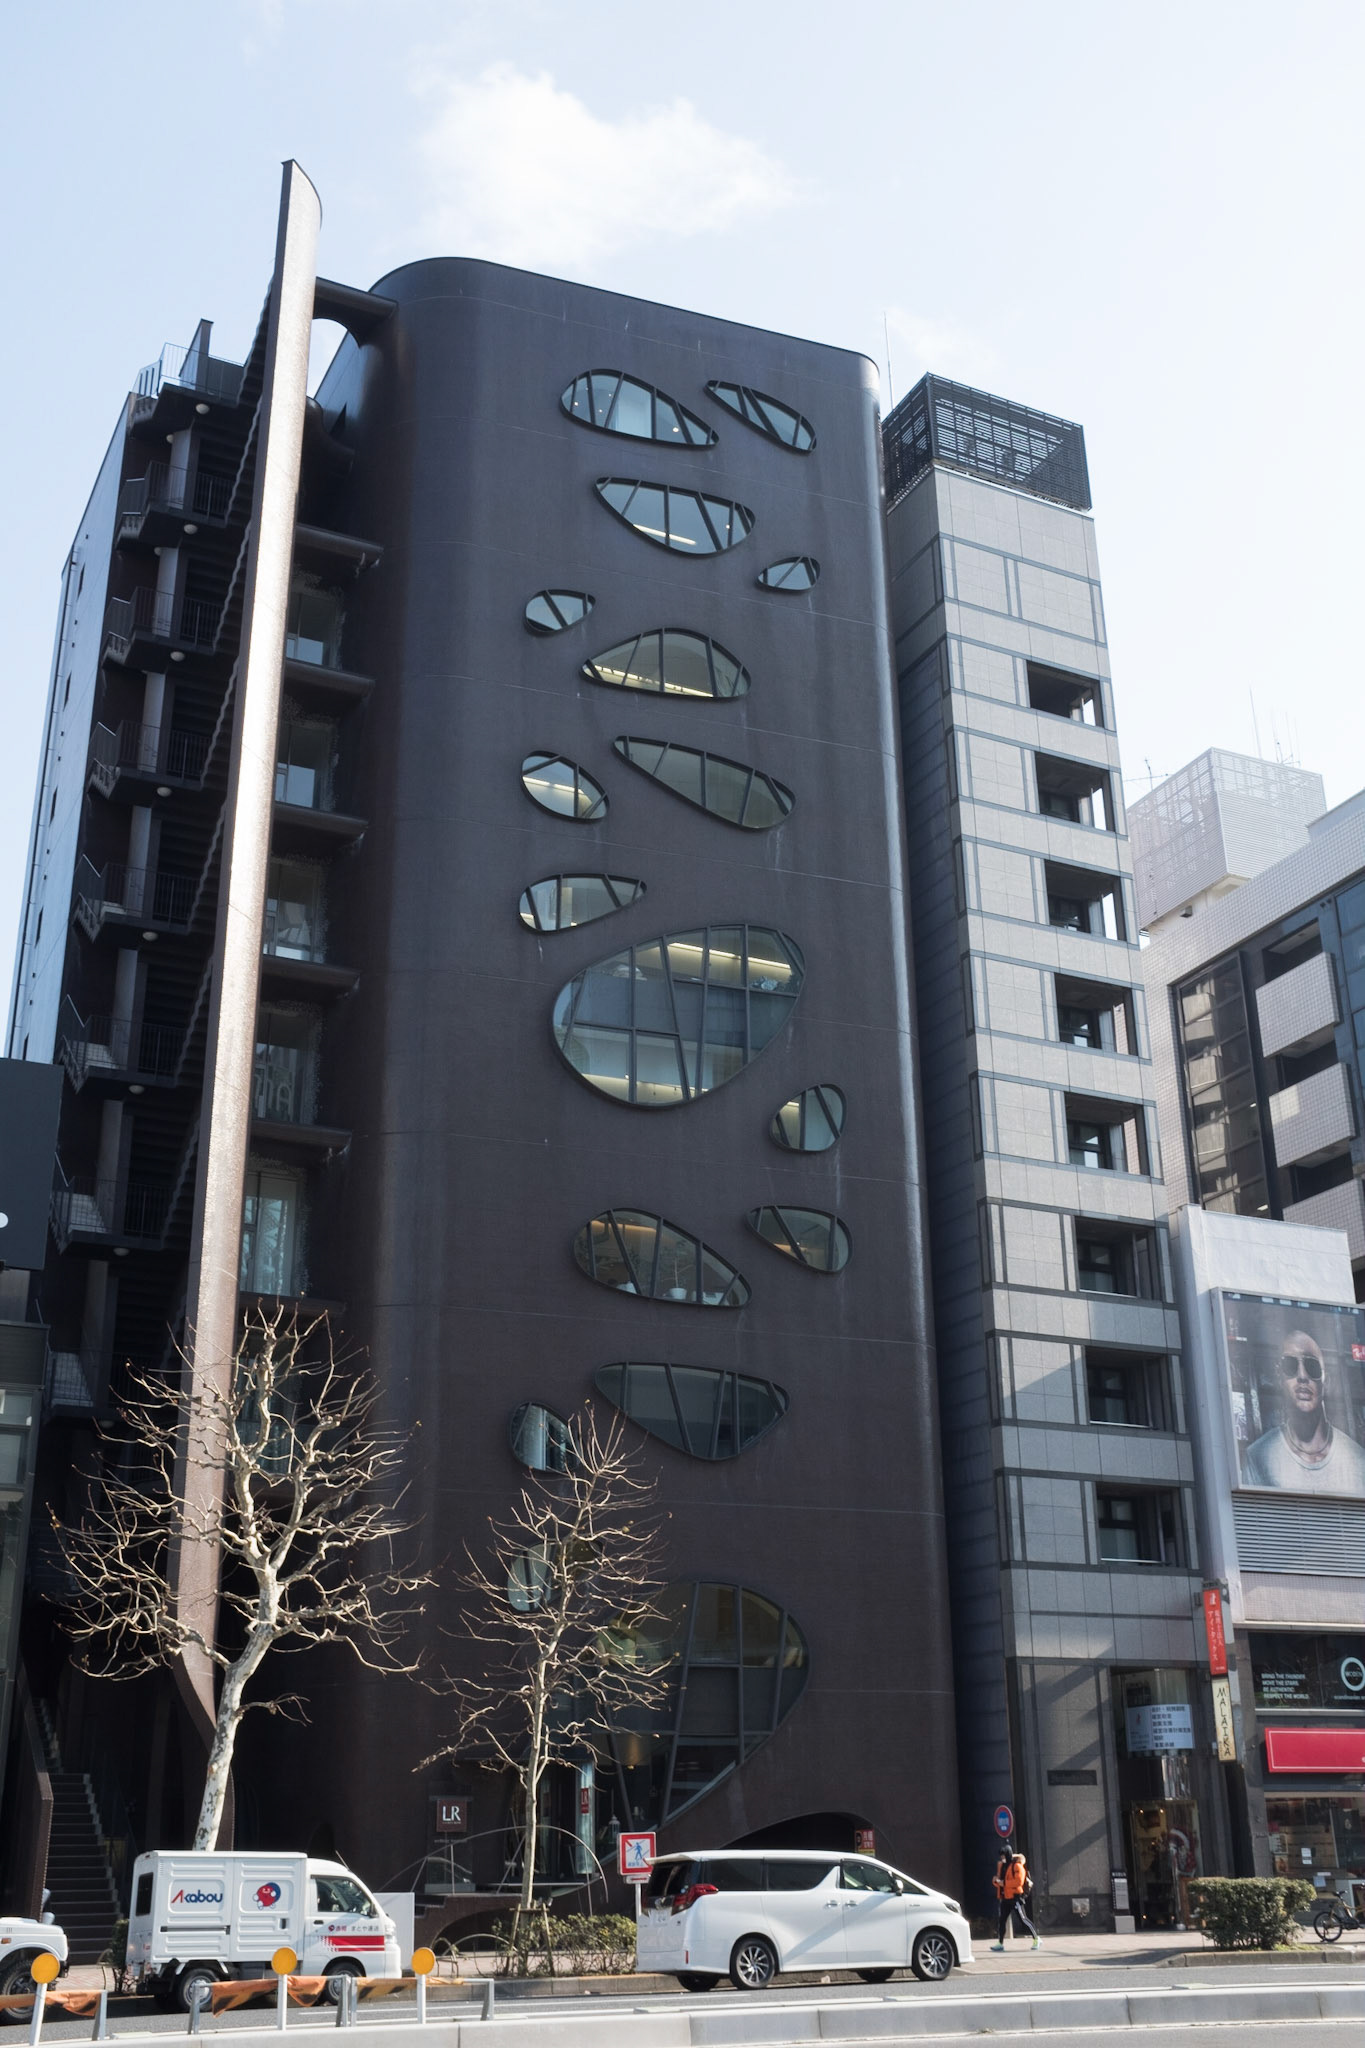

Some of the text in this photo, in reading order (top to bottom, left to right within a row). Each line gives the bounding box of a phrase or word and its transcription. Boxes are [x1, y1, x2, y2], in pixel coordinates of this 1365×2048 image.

[1217, 1687, 1231, 1757] MALAIKA
[442, 1805, 461, 1821] LR
[171, 1889, 223, 1904] Akabou
